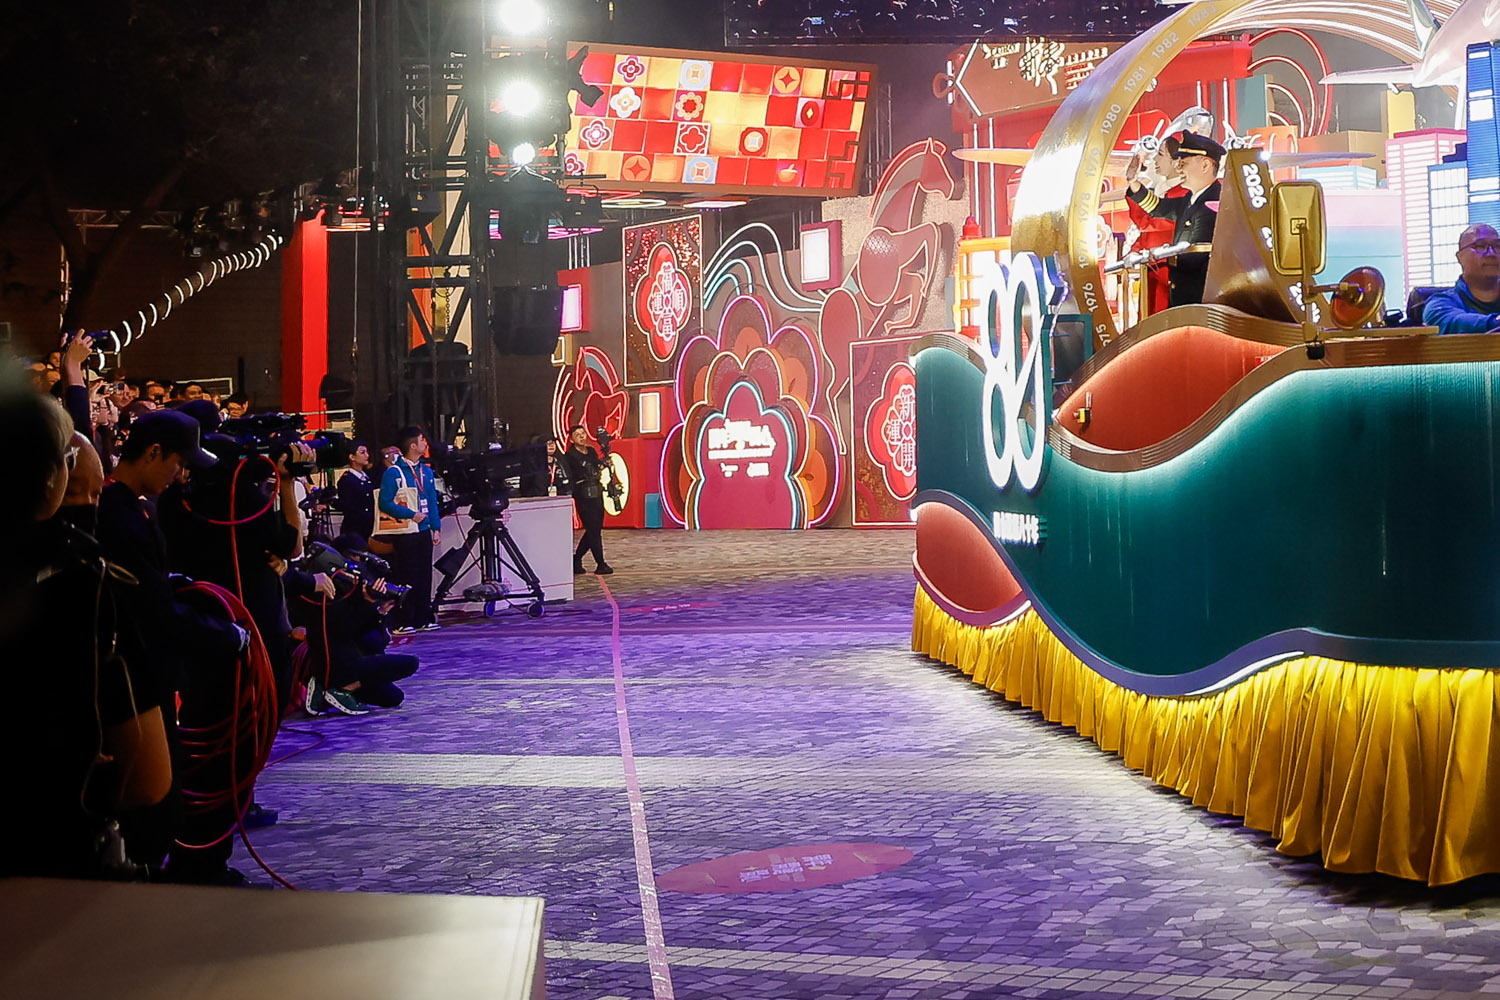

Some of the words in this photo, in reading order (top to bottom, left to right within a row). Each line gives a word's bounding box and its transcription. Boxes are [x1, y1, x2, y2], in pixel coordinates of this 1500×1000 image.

[1187, 3, 1218, 28] 1983
[1151, 31, 1181, 59] 1982
[1123, 66, 1147, 94] 1981
[1099, 103, 1123, 135] 1980
[1084, 146, 1101, 178] 1979
[1242, 163, 1267, 209] 2026
[1077, 192, 1092, 223] 1978
[1077, 238, 1089, 269] 1977
[1082, 282, 1099, 313] 1976
[1095, 323, 1112, 347] 975
[981, 252, 1047, 490] 80
